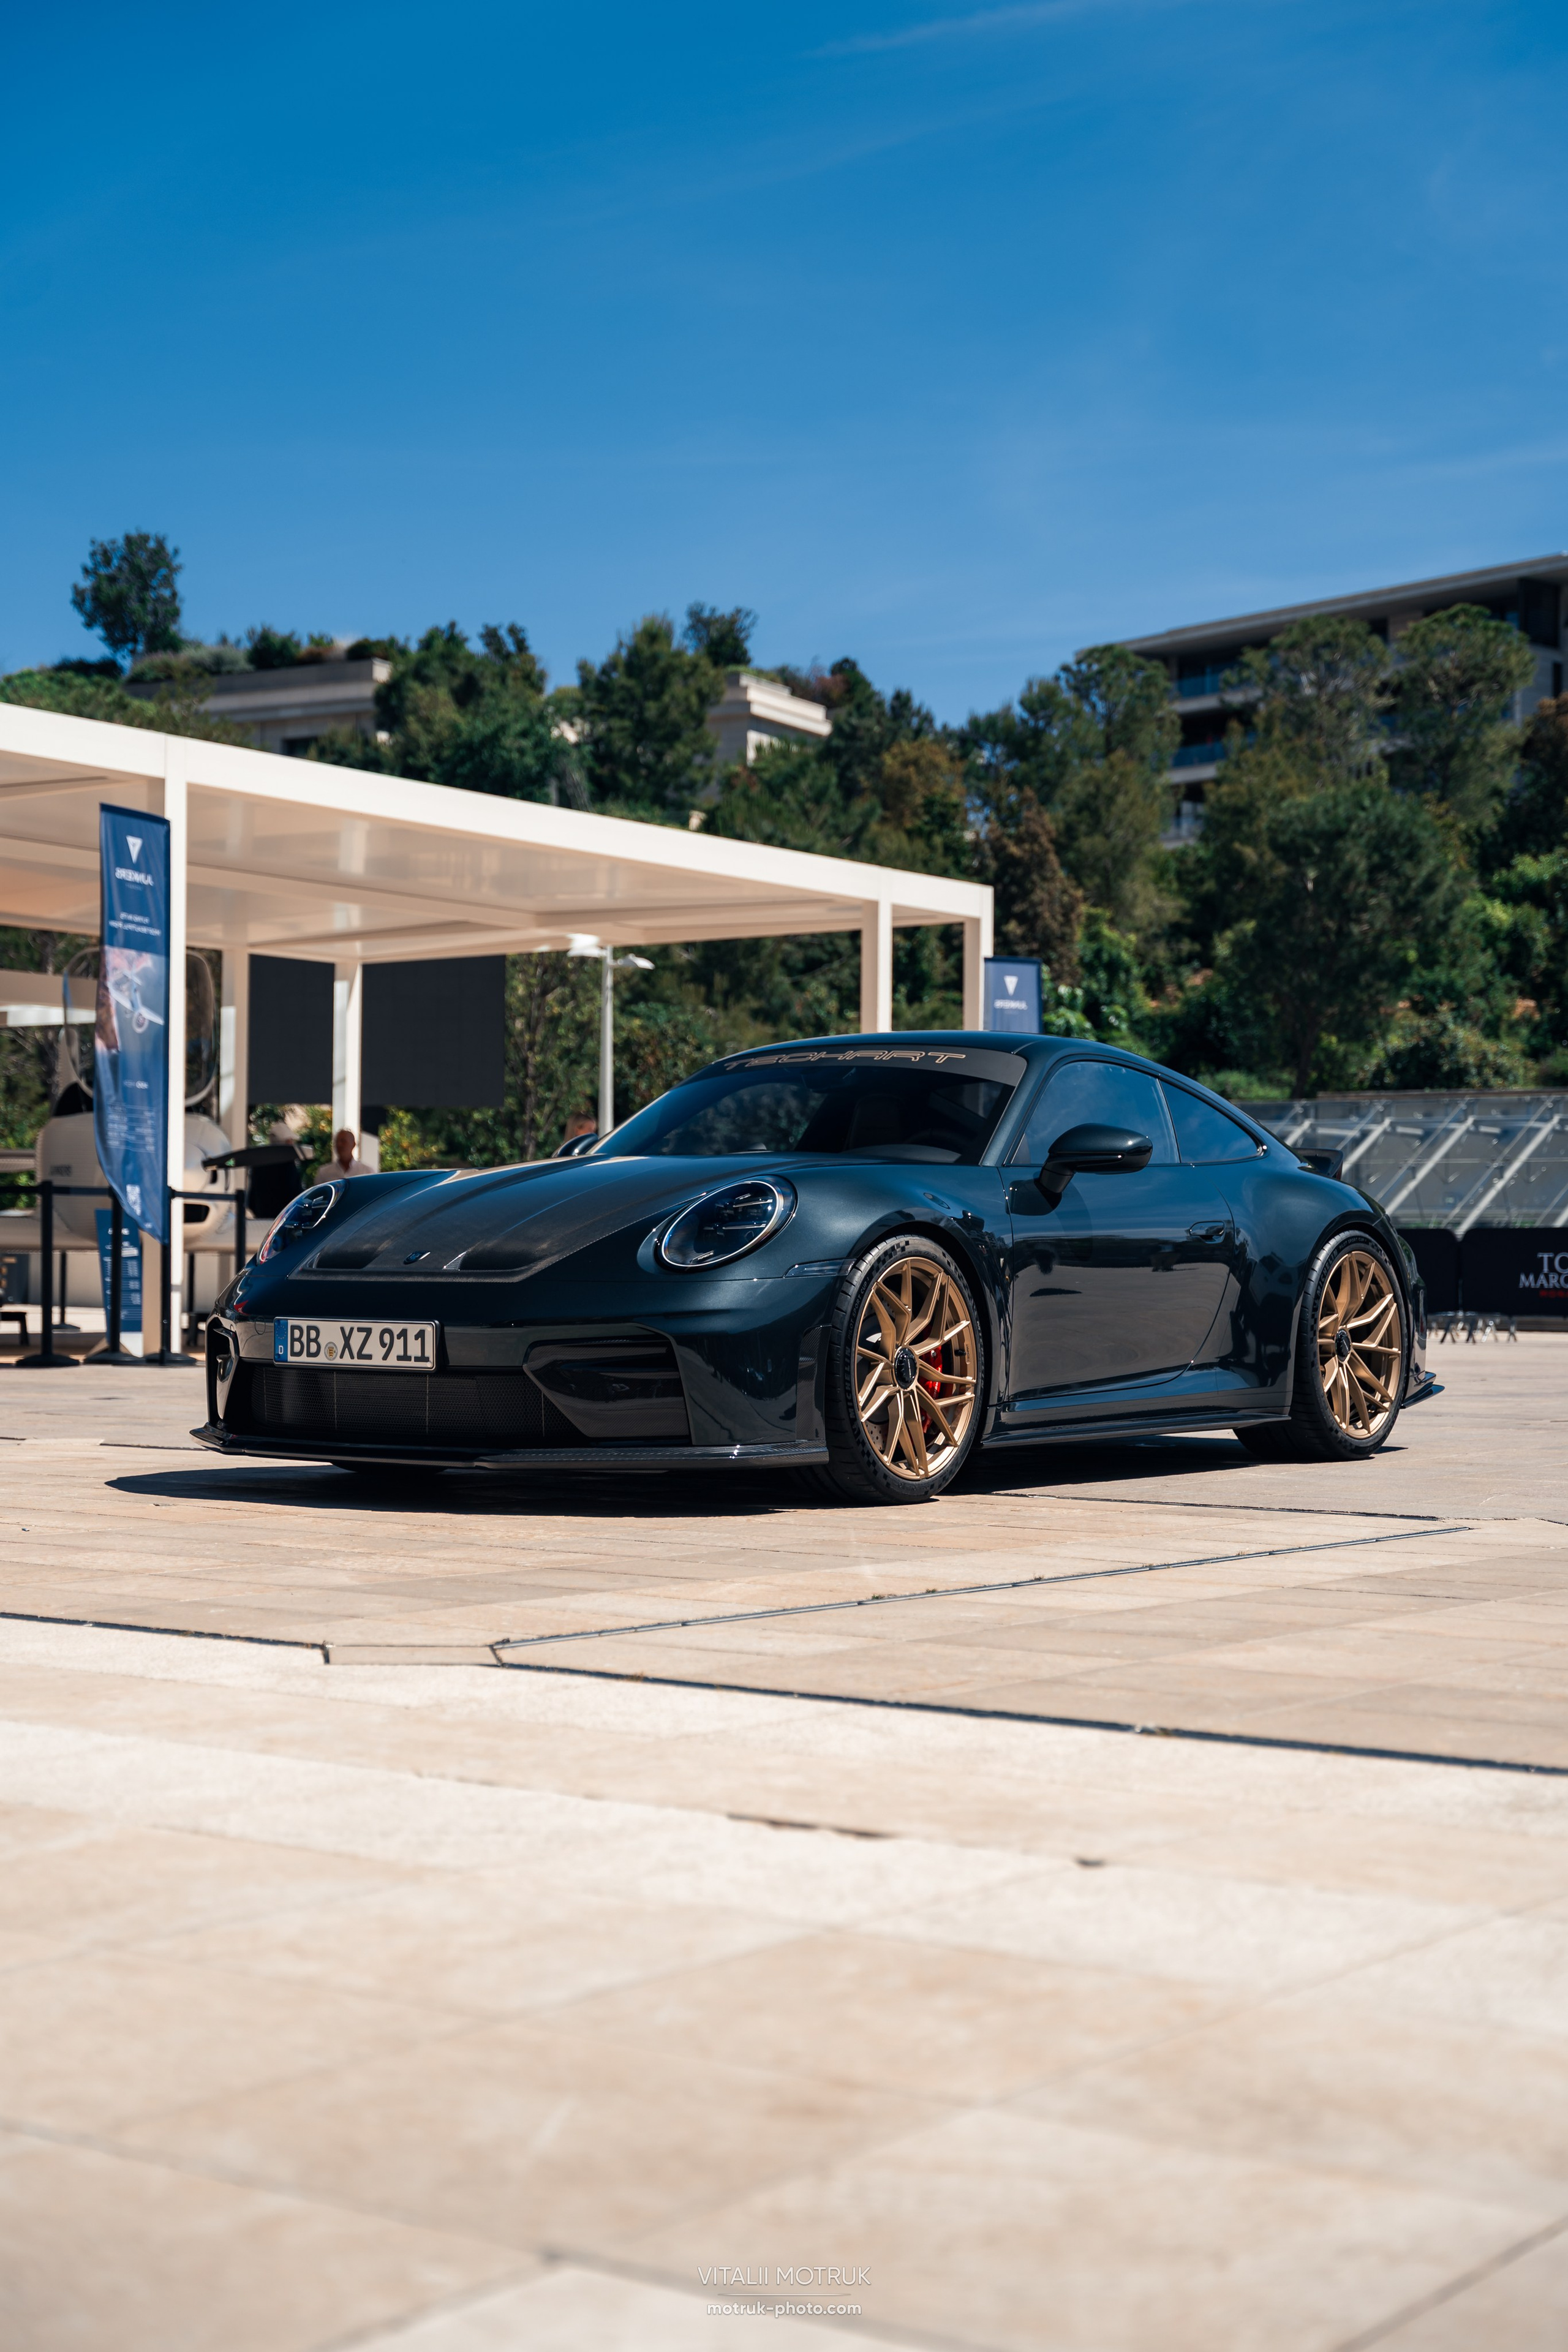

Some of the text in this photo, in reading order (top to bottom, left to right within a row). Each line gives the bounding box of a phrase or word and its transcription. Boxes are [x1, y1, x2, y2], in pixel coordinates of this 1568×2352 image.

[724, 1050, 966, 1071] TECHART
[1316, 1249, 1338, 1297] MICHELIN
[852, 1295, 861, 1317] SPORT
[278, 1345, 284, 1354] D
[290, 1325, 429, 1362] BB XZ 911
[845, 1347, 856, 1419] MICHELIN
